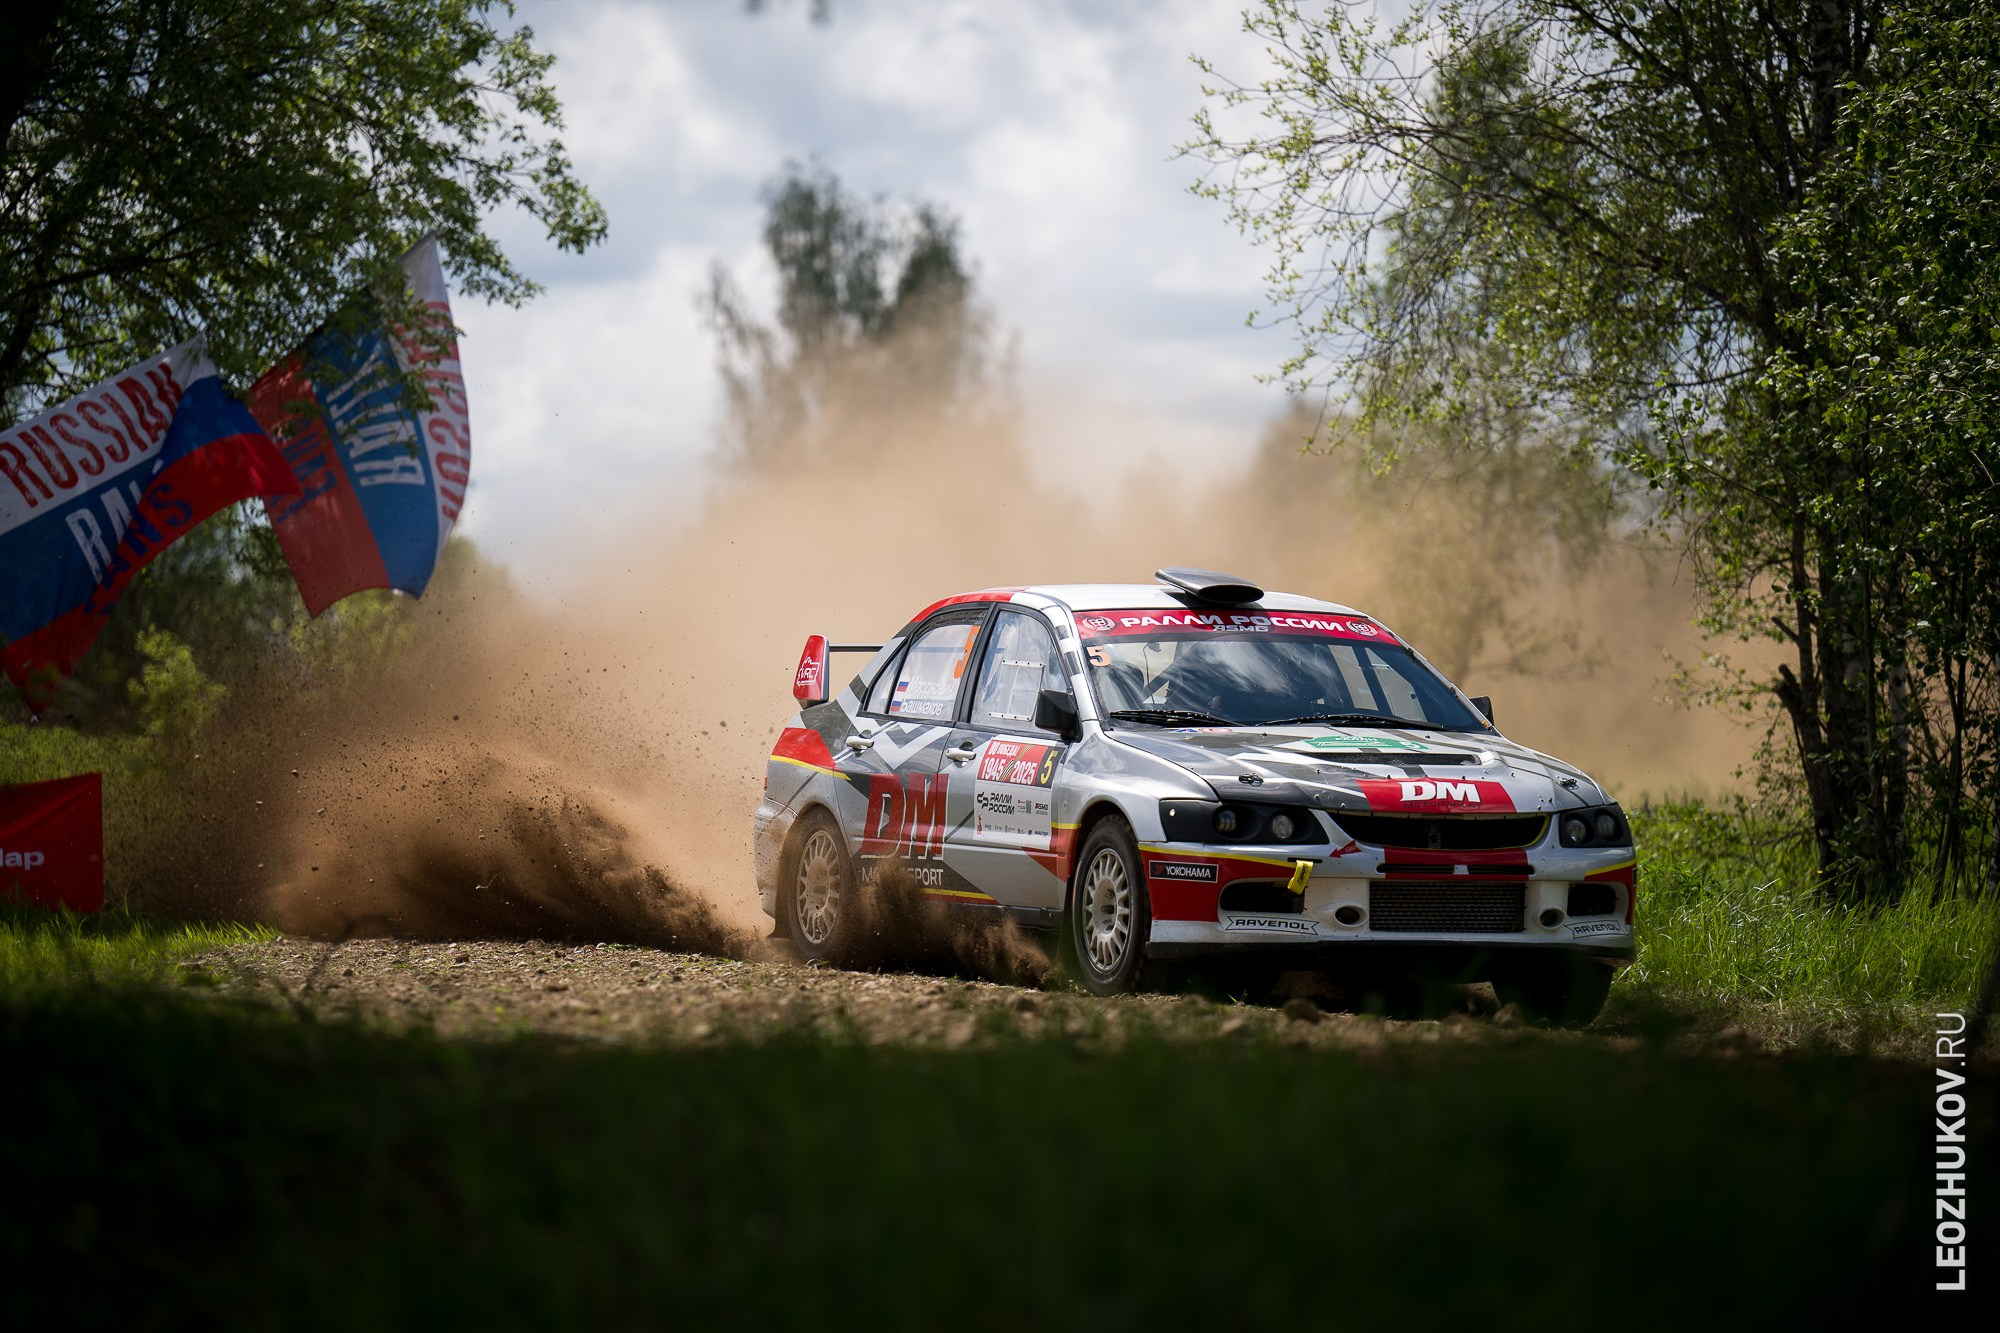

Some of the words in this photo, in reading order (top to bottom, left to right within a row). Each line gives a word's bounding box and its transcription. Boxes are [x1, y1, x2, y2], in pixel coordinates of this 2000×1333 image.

[1120, 615, 1224, 628] РАЛЛИ
[1230, 615, 1346, 632] РОССИИ
[1086, 645, 1112, 668] 5
[981, 758, 1006, 780] 1945
[1009, 761, 1038, 785] 2025
[1040, 750, 1059, 785] 5
[990, 793, 1012, 804] РАЛЛИ
[1398, 781, 1480, 803] DM
[859, 773, 950, 860] DM
[988, 803, 1015, 815] РОССИИ
[1165, 866, 1212, 878] YOKOHAMA
[1235, 918, 1310, 930] RAVENOL
[1574, 923, 1621, 934] RAVENOL
